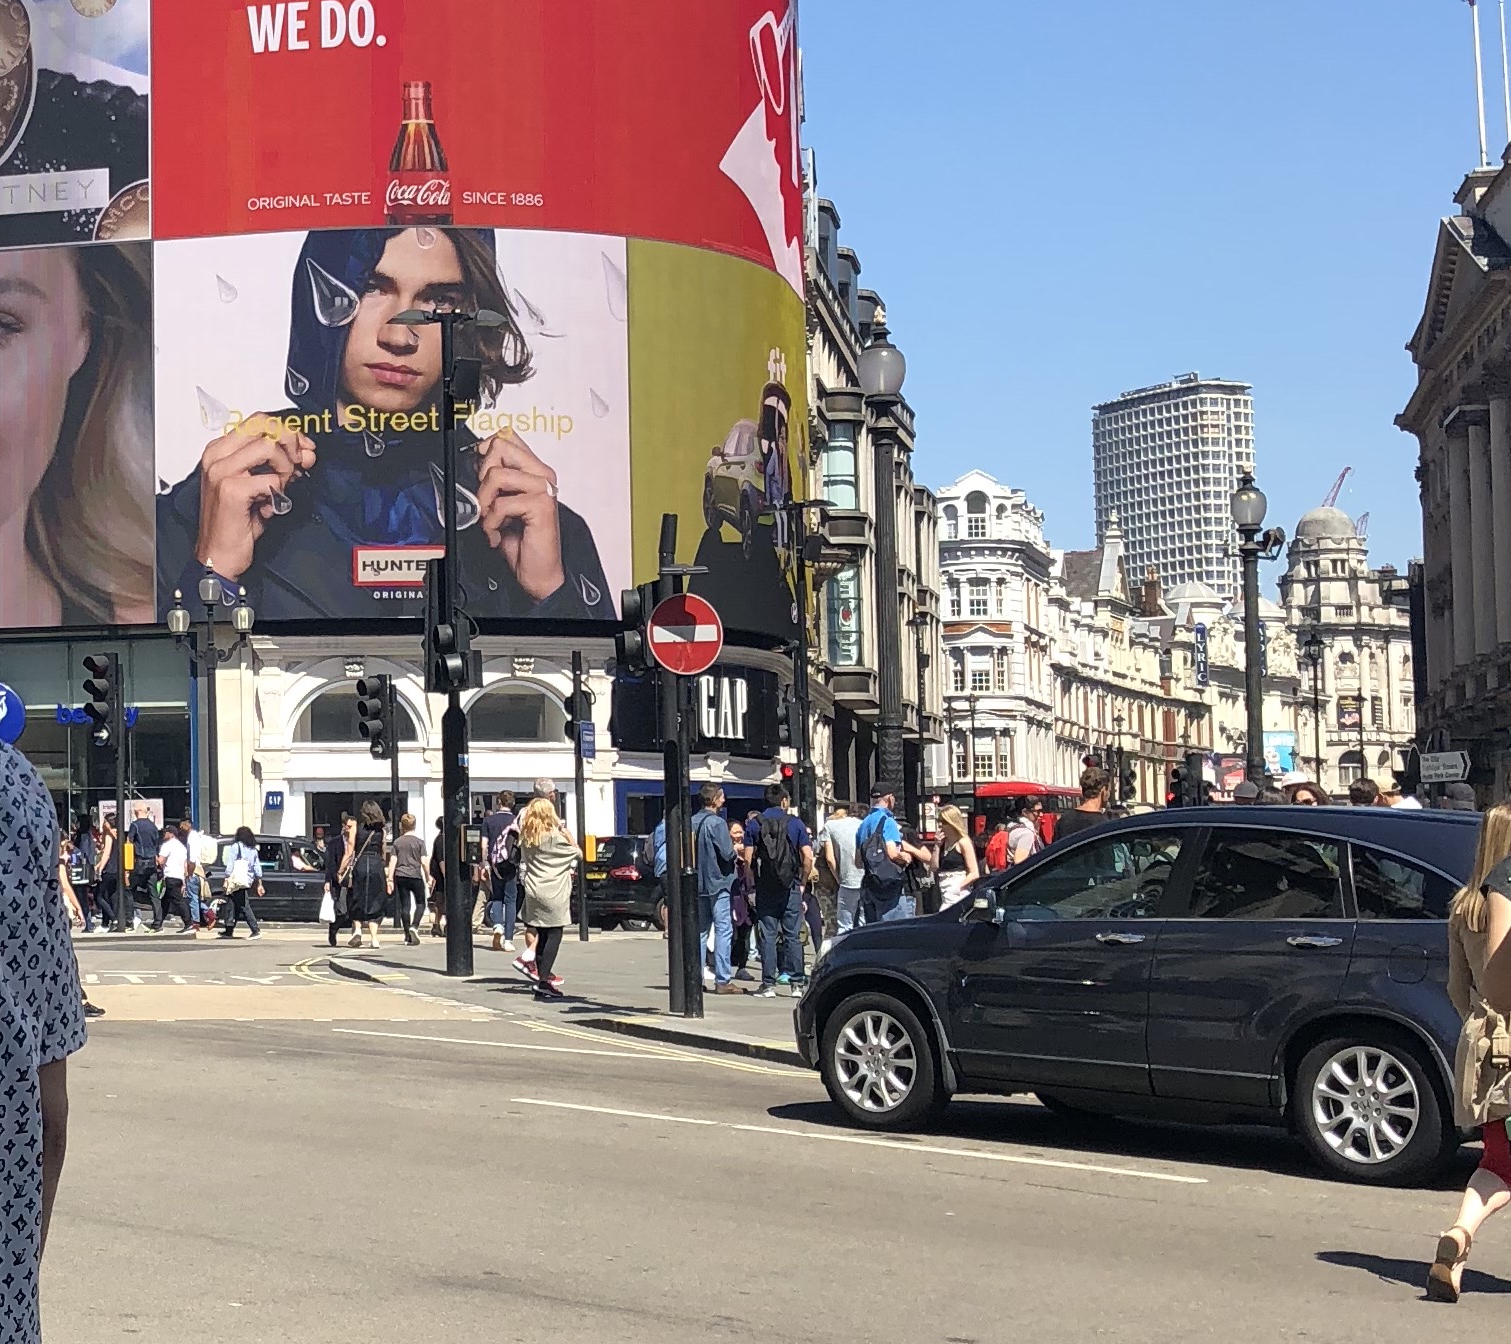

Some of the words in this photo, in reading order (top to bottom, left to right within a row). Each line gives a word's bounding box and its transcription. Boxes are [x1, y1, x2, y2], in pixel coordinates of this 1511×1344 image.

[247, 1, 310, 54] WE
[247, 193, 320, 211] ORIGINAL
[323, 191, 371, 206] TASTE
[462, 191, 507, 205] SINCE
[510, 193, 544, 207] 1886
[222, 407, 332, 442] Regent
[342, 403, 439, 433] Street
[453, 403, 574, 440] Flagship
[362, 560, 427, 572] HUNTE
[373, 590, 424, 599] ORIGINA
[1196, 633, 1207, 682] LYRIC
[56, 702, 139, 727] bey
[699, 675, 748, 740] GAP
